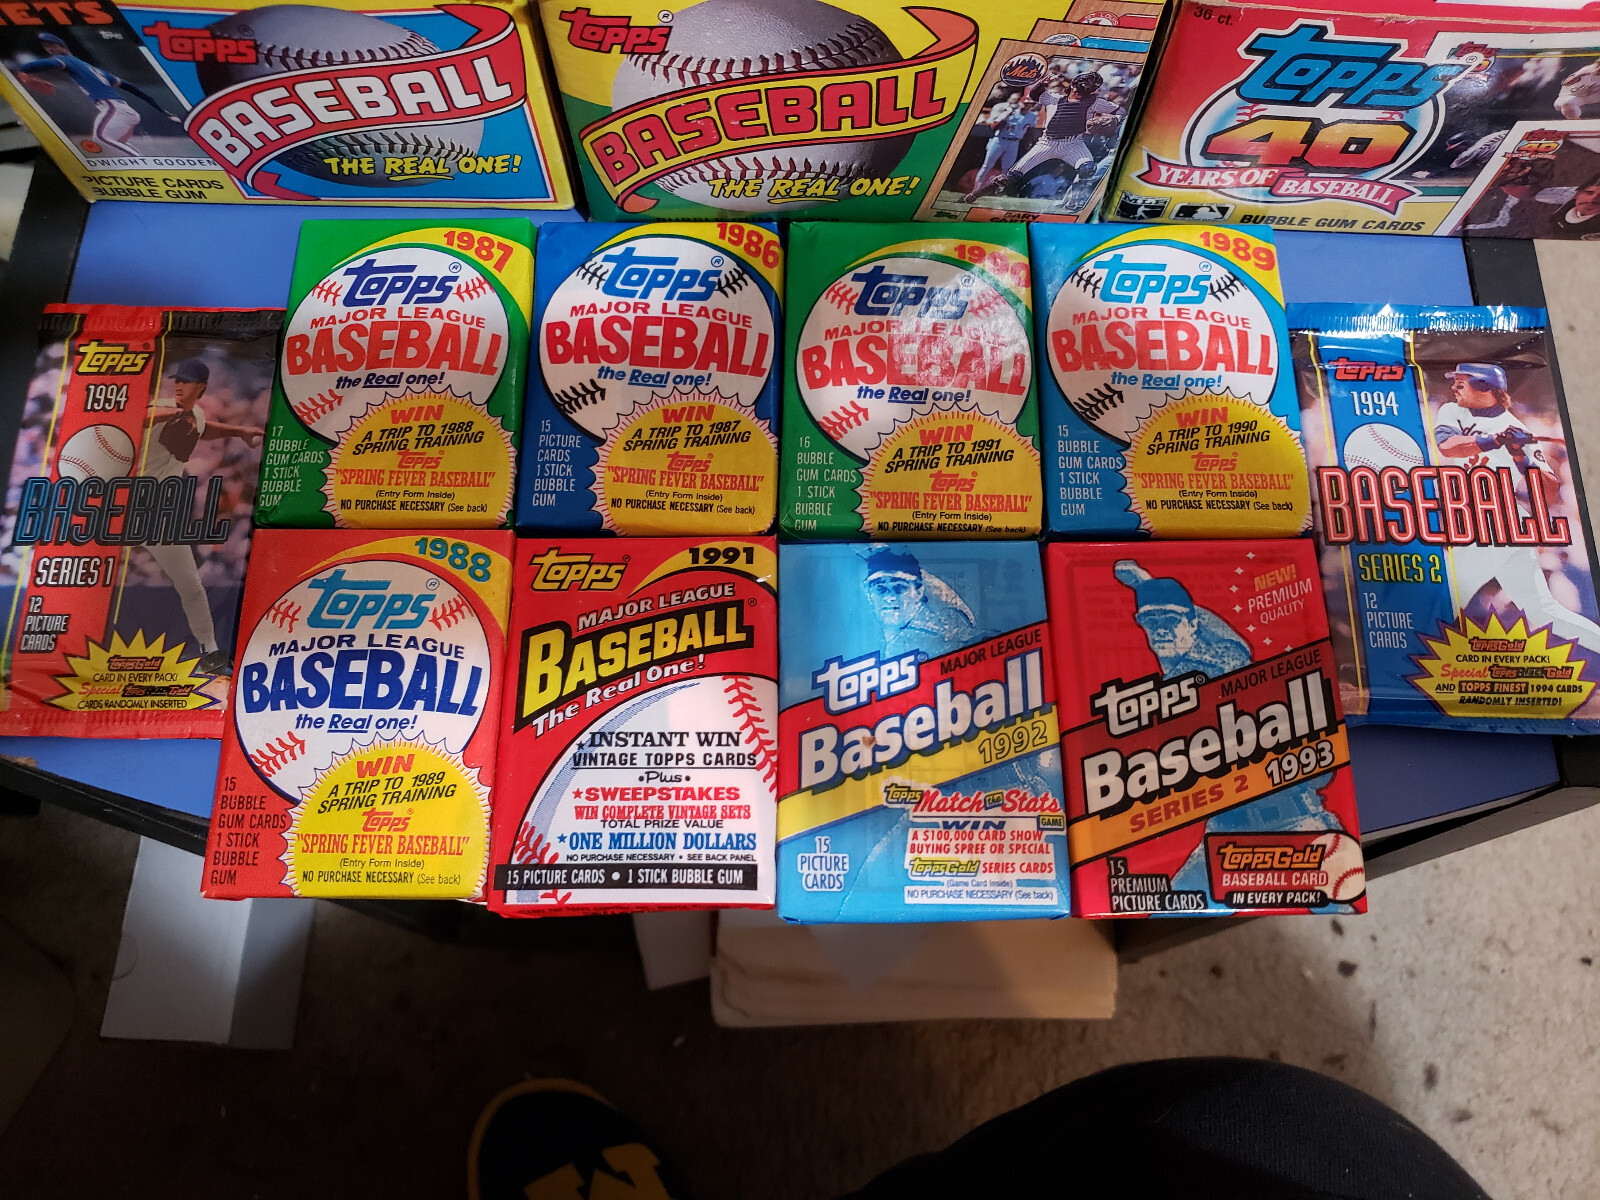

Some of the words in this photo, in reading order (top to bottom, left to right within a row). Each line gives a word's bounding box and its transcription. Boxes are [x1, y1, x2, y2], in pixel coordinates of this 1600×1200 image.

[0, 1, 114, 26] ETS
[1193, 7, 1214, 20] 36
[1217, 13, 1234, 27] ct.
[1006, 65, 1038, 79] Mets
[198, 55, 511, 163] BASEBALL
[590, 66, 946, 187] BASEBALL
[1203, 115, 1414, 169] 40
[87, 159, 147, 167] DWIGHT
[154, 159, 218, 167] GOODEN
[325, 158, 375, 176] THE
[387, 157, 450, 176] REAL
[459, 154, 522, 174] ONE!
[162, 179, 225, 189] CARDS
[708, 179, 760, 198] THE
[769, 179, 840, 198] REAL
[849, 176, 921, 196] ONE!
[1155, 164, 1238, 188] YEARS
[1239, 168, 1278, 186] OF
[1278, 179, 1395, 207] BASEBALL
[166, 189, 208, 200] GUM
[1239, 213, 1310, 227] BUBBLE
[1315, 216, 1357, 230] GUM
[1360, 218, 1426, 232] CARDS
[444, 231, 513, 273] 1987
[718, 222, 779, 269] 1986
[1200, 232, 1275, 271] 1989
[310, 308, 386, 329] MAJOR
[398, 307, 485, 329] LEAGUE
[287, 321, 502, 376] BASEBALL
[546, 316, 769, 378] BASEBALL
[1052, 321, 1274, 376] BASEBALL
[802, 333, 1026, 396] BASEBALL
[336, 377, 360, 389] the
[363, 372, 403, 388] Real
[406, 372, 444, 385] one!
[85, 385, 127, 412] 1994
[1350, 391, 1399, 417] 1994
[391, 405, 444, 424] WIN
[541, 420, 551, 432] 15
[632, 429, 642, 439] A
[648, 426, 681, 438] TRIP
[687, 424, 703, 435] TO
[709, 420, 740, 433] 1987
[1058, 425, 1068, 437] 15
[539, 435, 581, 448] PICTURE
[623, 439, 678, 452] SPRING
[683, 430, 751, 448] TRAINING
[799, 436, 810, 448] 16
[1058, 440, 1100, 453] BUBBLE
[538, 450, 570, 462] CARDS
[1058, 457, 1084, 469] GUM
[1087, 457, 1122, 470] CARDS
[537, 465, 541, 476] 1
[544, 465, 573, 477] STICK
[534, 479, 575, 492] BUBBLE
[1134, 473, 1185, 488] "SPRING
[1188, 474, 1227, 489] FEVER
[1231, 475, 1293, 490] BASEBALL"
[341, 500, 352, 510] NO
[355, 500, 396, 511] PURCHASE
[400, 501, 445, 512] NECESSARY
[448, 502, 464, 512] (See
[467, 503, 488, 513] back)
[532, 494, 556, 506] GUM
[870, 492, 920, 510] "SPRING
[923, 493, 963, 510] FEVER
[965, 494, 1032, 512] BASEBALL"
[1317, 467, 1571, 546] BASEBALL
[13, 476, 229, 545] BASEBALL
[912, 511, 936, 522] (Entry
[939, 511, 961, 520] Form
[963, 511, 992, 521] Inside)
[415, 538, 491, 582] 1988
[689, 547, 755, 565] 1991
[35, 557, 102, 586] SERIES
[104, 556, 114, 585] 1
[1254, 564, 1297, 591] NEW!
[1359, 553, 1425, 582] SERIES
[1430, 554, 1442, 583] 2
[1248, 578, 1312, 612] PREMIUM
[1364, 593, 1377, 609] 12
[29, 597, 41, 613] 12
[577, 598, 653, 631] MAJOR
[658, 582, 735, 608] LEAGUE
[1260, 599, 1306, 624] QUALITY
[25, 614, 69, 633] PICTURE
[1367, 612, 1414, 630] PICTURE
[20, 634, 56, 652] CARDS
[269, 634, 356, 657] MAJOR
[368, 633, 465, 659] LEAGUE
[1370, 631, 1407, 649] CARDS
[1482, 655, 1491, 663] IN
[1494, 655, 1520, 663] EVERY
[1523, 655, 1550, 663] PACK!
[243, 649, 483, 716] BASEBALL
[1435, 683, 1455, 693] AND
[1461, 682, 1490, 692] TOPPS
[1494, 683, 1526, 692] FINEST
[1556, 685, 1582, 693] CARDS
[78, 700, 102, 709] CARDS
[105, 700, 148, 709] RANDOMLY
[151, 700, 187, 708] INSERTED
[532, 706, 578, 738] The
[586, 675, 642, 706] Real
[647, 655, 705, 683] One!
[1459, 696, 1512, 706] RANDOMLY
[1515, 697, 1562, 706] INSERTED!
[801, 648, 1044, 789] Baseball
[590, 731, 688, 747] INSTANT
[696, 731, 742, 747] WIN
[978, 721, 1048, 764] 1992
[1084, 672, 1327, 814] Baseball
[573, 752, 637, 767] VINTAGE
[646, 753, 695, 766] TOPPS
[704, 752, 756, 766] CARDS
[1266, 740, 1334, 786] 1993
[317, 792, 375, 814] SPRING
[381, 784, 457, 806] TRAINING
[1130, 783, 1224, 833] SERIES
[1234, 775, 1249, 792] 2
[218, 815, 245, 828] GUM
[249, 813, 287, 828] CARDS
[816, 837, 830, 853] 15
[912, 831, 918, 841] A
[923, 830, 973, 842] $100,000
[978, 831, 1005, 841] CARD
[1010, 831, 1043, 841] SHOW
[800, 855, 847, 871] PICTURE
[1109, 860, 1124, 875] 15
[804, 873, 843, 889] CARDS
[1111, 878, 1168, 892] PREMIUM
[1112, 894, 1161, 911] PICTURE
[1163, 892, 1205, 909] CARDS
